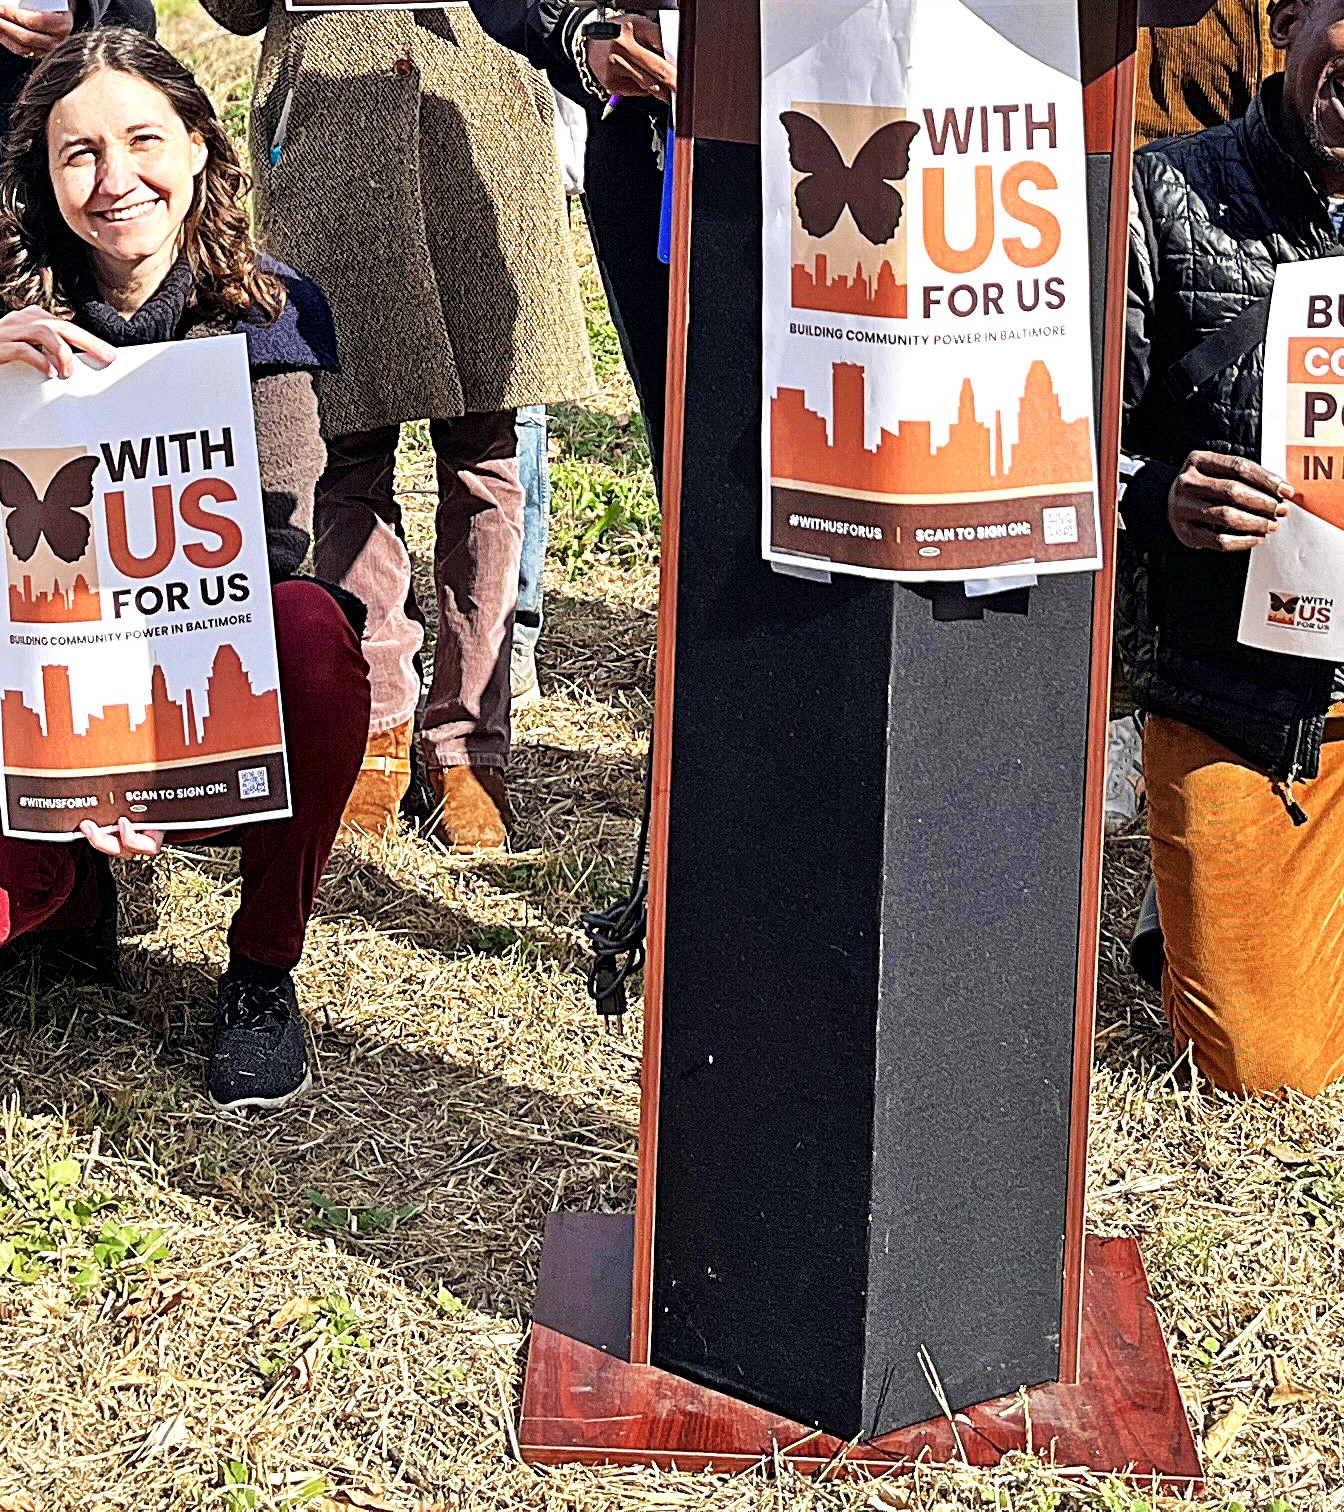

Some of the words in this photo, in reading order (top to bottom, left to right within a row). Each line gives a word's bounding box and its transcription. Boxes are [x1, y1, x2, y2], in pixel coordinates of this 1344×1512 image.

[922, 101, 1058, 156] WITH
[922, 160, 1060, 274] US
[922, 281, 1004, 319] FOR
[1017, 276, 1066, 312] US
[790, 323, 843, 339] BUILDING
[846, 330, 929, 346] COMMUNITY
[933, 332, 981, 345] POWER
[984, 332, 997, 342] IN
[1000, 326, 1066, 341] BALTIMORE
[100, 427, 234, 483] WITH
[1303, 455, 1333, 481] IN
[103, 477, 242, 580] US
[789, 514, 882, 540] #WITHUSFORUS
[916, 527, 954, 542] SCAN
[957, 527, 974, 540] TO
[976, 524, 1006, 539] SIGN
[113, 582, 190, 619] FOR
[200, 573, 250, 606] US
[1301, 595, 1333, 607] WITH
[10, 634, 48, 646] BUILDING
[51, 632, 122, 646] COMMUNITY
[125, 626, 169, 640] POWER
[171, 623, 183, 634] IN
[186, 613, 252, 632] BALTIMORE
[1297, 621, 1316, 629] FOR
[1299, 606, 1331, 623] US
[20, 795, 98, 808] #WITHUSFORUS
[126, 791, 157, 801] SCAN
[159, 790, 174, 800] TO
[177, 786, 204, 798] SIGN
[206, 783, 227, 795] ON:
